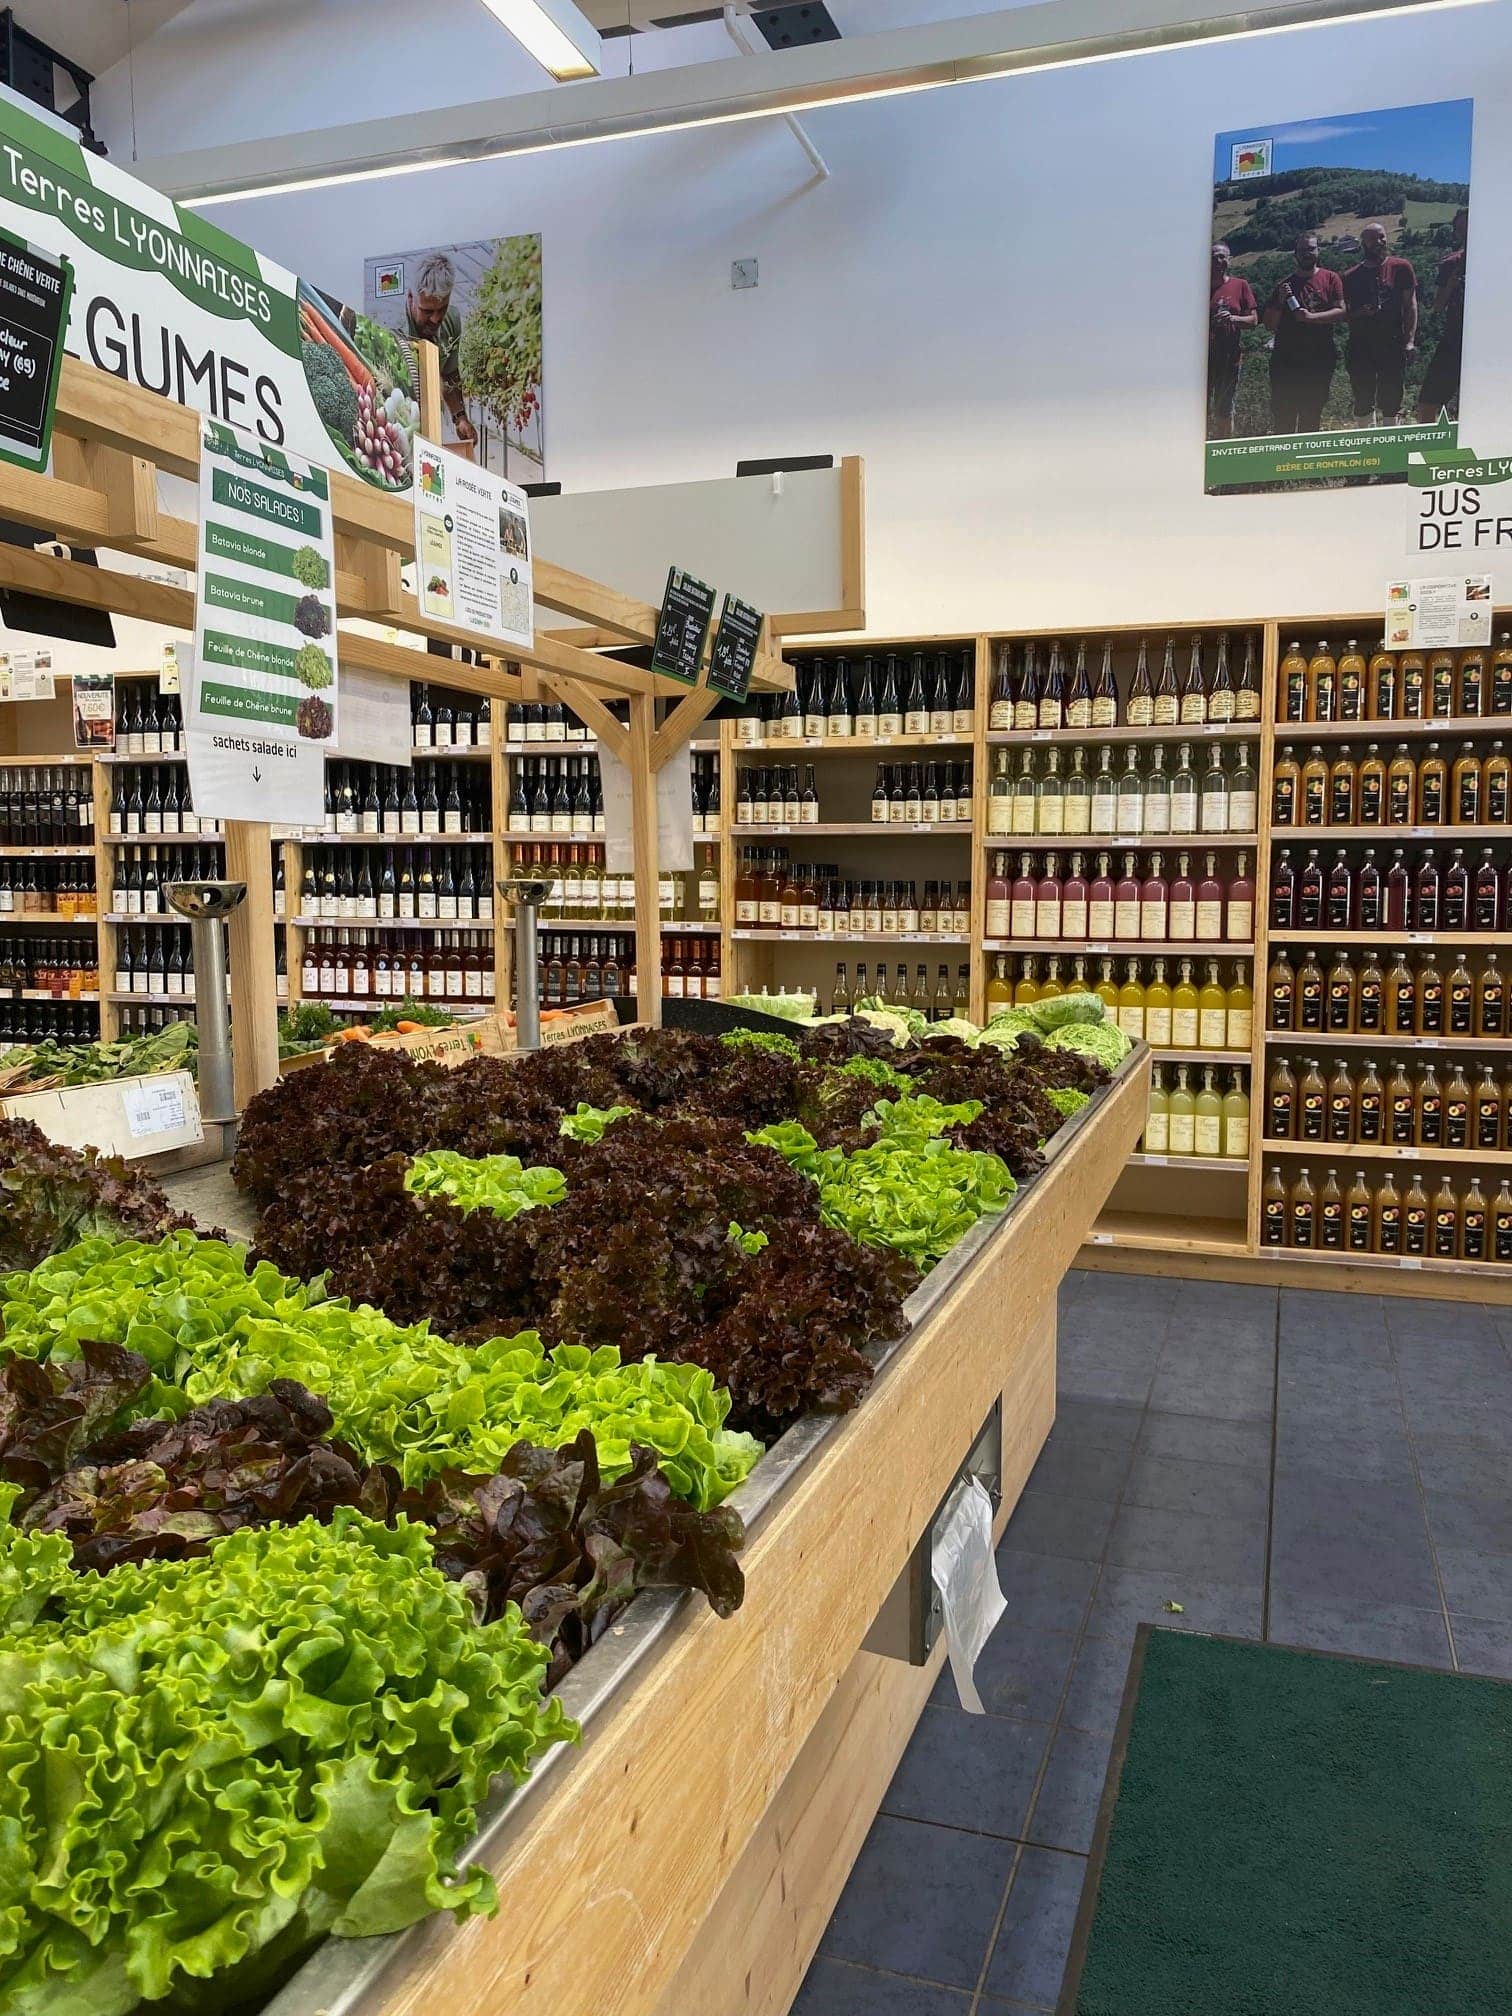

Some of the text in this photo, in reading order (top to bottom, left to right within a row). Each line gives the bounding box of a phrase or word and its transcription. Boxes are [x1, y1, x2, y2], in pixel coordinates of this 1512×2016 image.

[3, 145, 271, 322] Terres LYONNAISES
[8, 256, 35, 281] CHÊNE
[36, 270, 61, 294] VERTE
[64, 296, 284, 446] GUMES
[1211, 447, 1247, 456] INVITEZ
[1249, 443, 1291, 454] BERTRAND
[1292, 442, 1303, 450] ET
[1306, 440, 1332, 449] TOUTE
[1333, 436, 1371, 447] L'ÉQUIPE
[1373, 436, 1396, 444] POUR
[1398, 431, 1447, 442] L'APÉRITIF
[1276, 461, 1303, 472] BIÈRE
[1304, 461, 1315, 470] DE
[1429, 460, 1512, 480] Terres LY
[228, 482, 251, 504] NOS
[254, 492, 299, 522] SALADES
[1420, 487, 1481, 518] JUS
[212, 534, 266, 558] Batavia blonde
[1419, 520, 1463, 550] DE
[210, 585, 264, 607] Batavia brune
[208, 641, 294, 667] Feuille de Chêne blonde
[205, 693, 292, 716] Feuille de Chêne brune
[213, 736, 297, 758] sachets salade ici
[541, 1020, 608, 1043] Terres LYONNAISES
